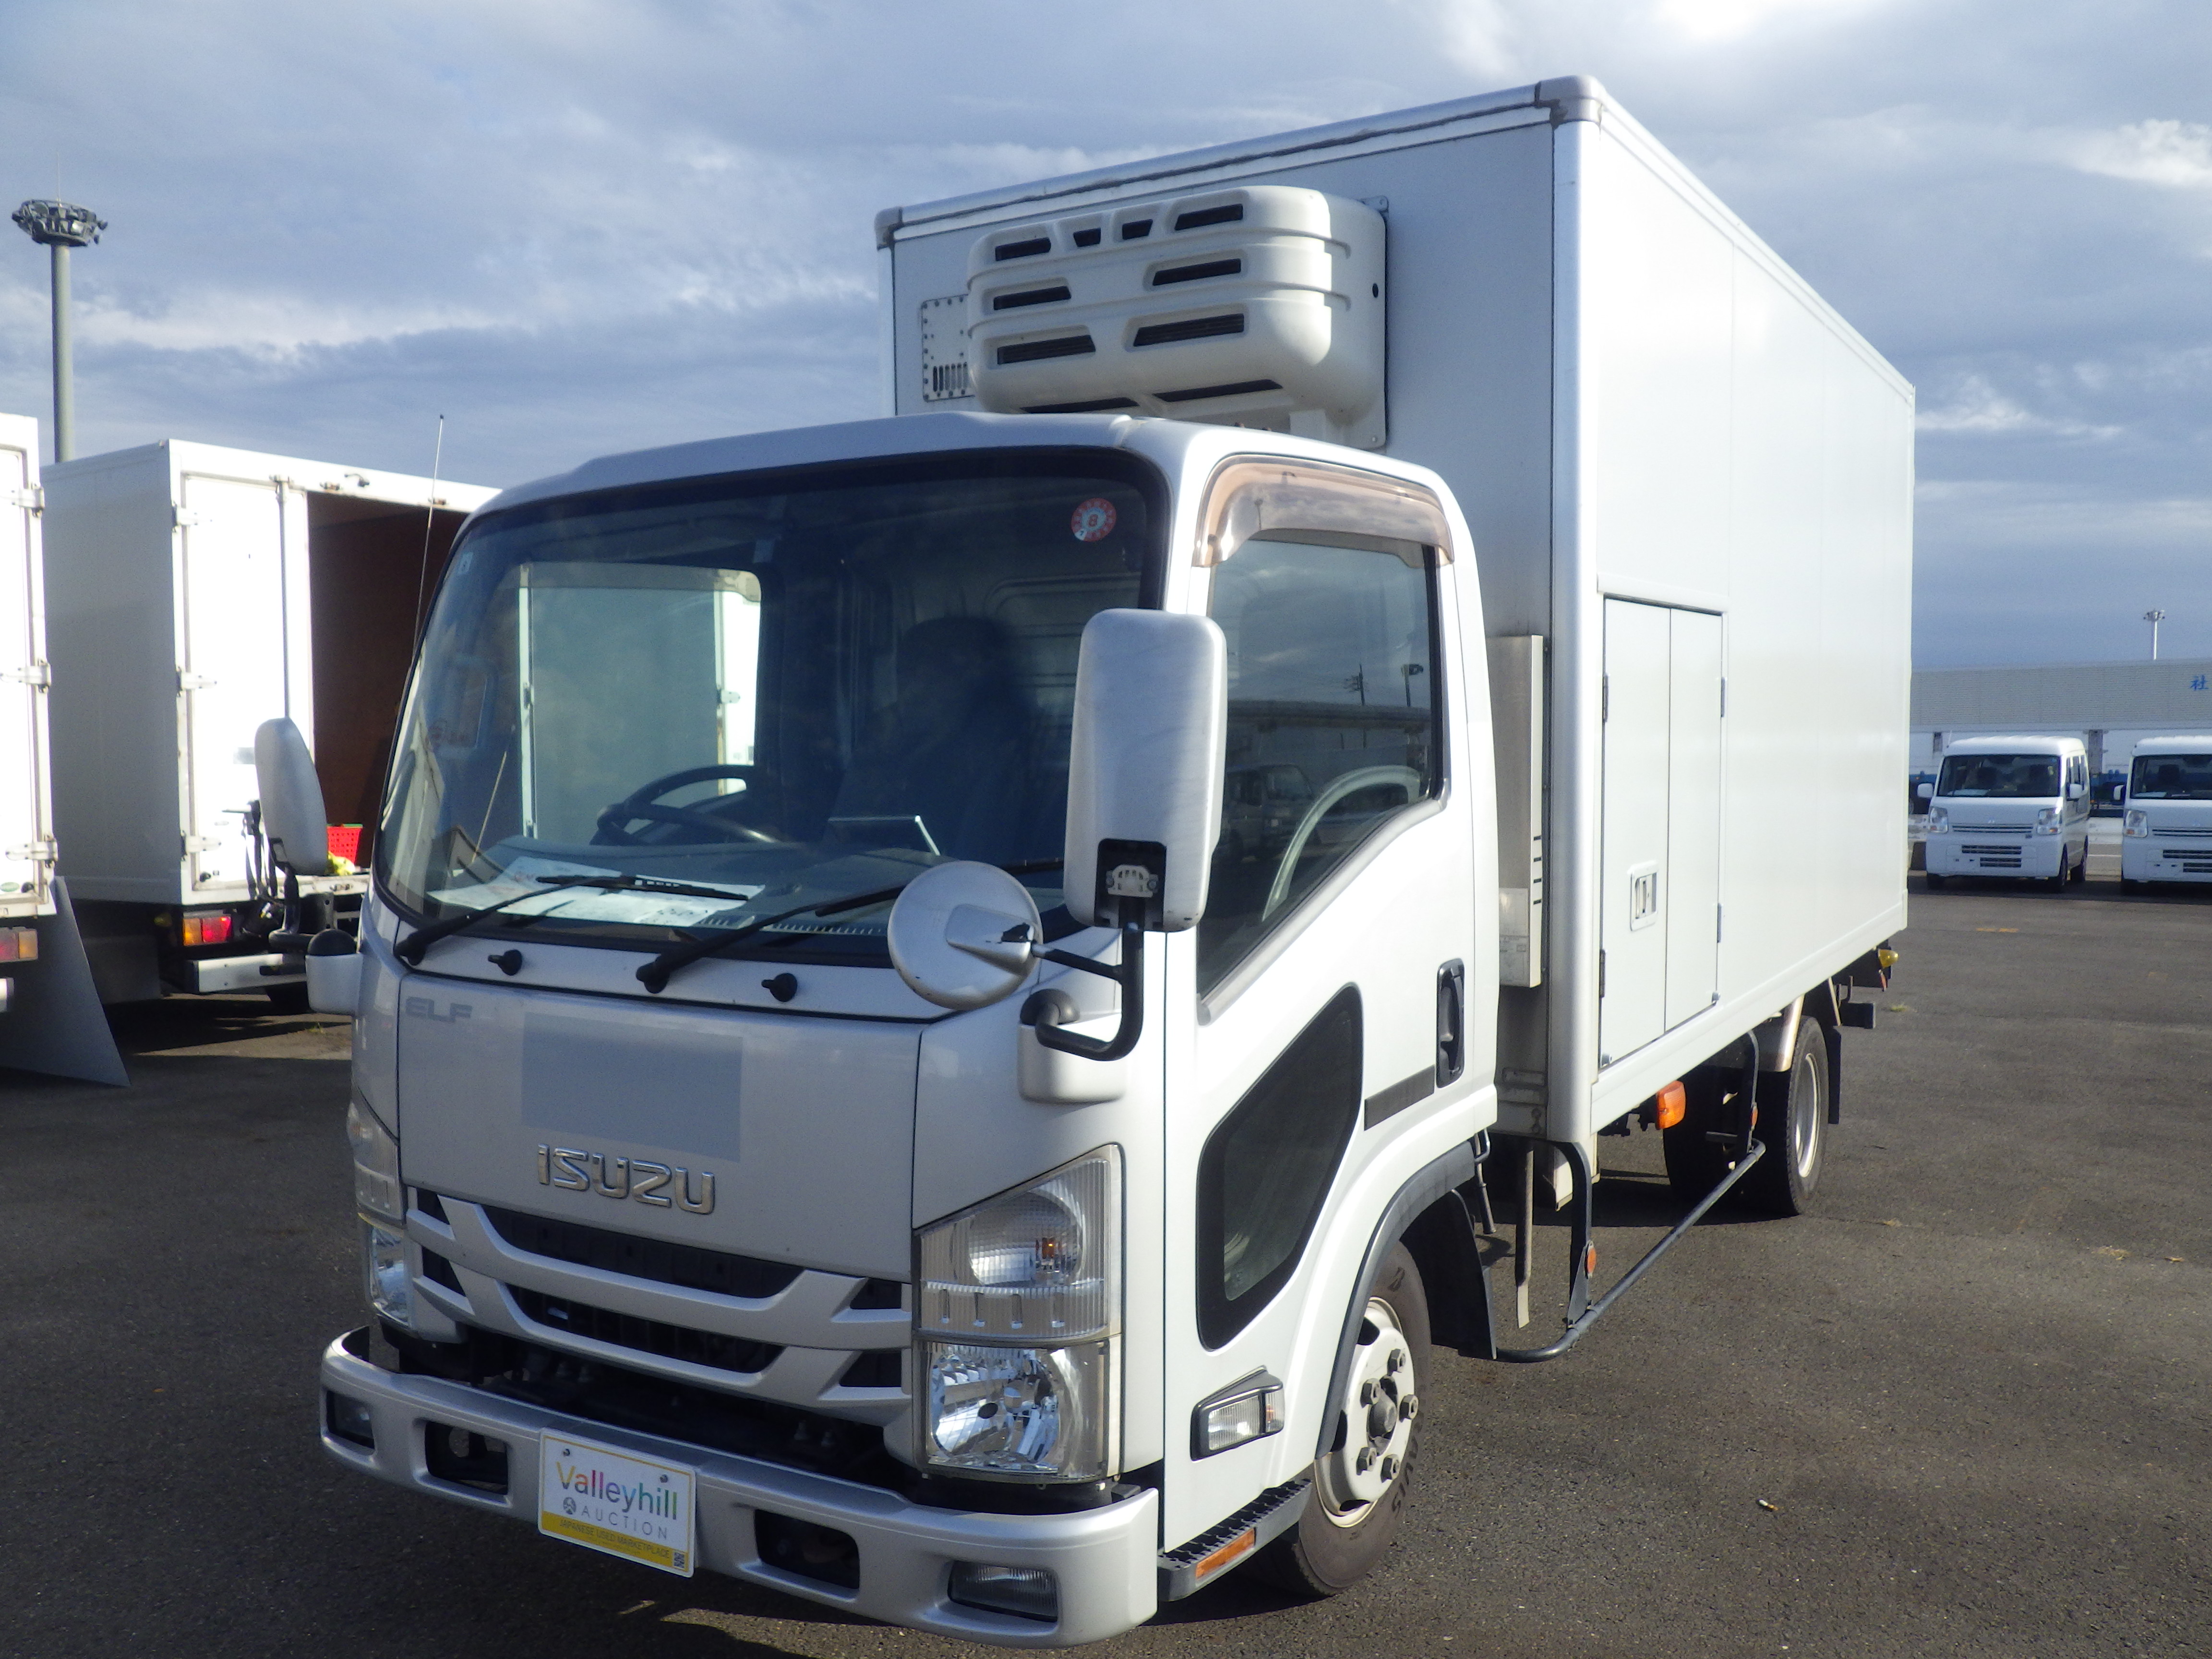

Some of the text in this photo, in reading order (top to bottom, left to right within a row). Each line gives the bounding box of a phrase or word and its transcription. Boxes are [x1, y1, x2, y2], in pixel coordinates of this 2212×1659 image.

[2190, 675, 2208, 690] 社
[537, 1143, 715, 1214] ISUZU
[556, 1461, 677, 1520] Valleyhill
[560, 1519, 594, 1536] JAPANESE
[597, 1529, 615, 1542] USED
[581, 1505, 667, 1539] AUCTION
